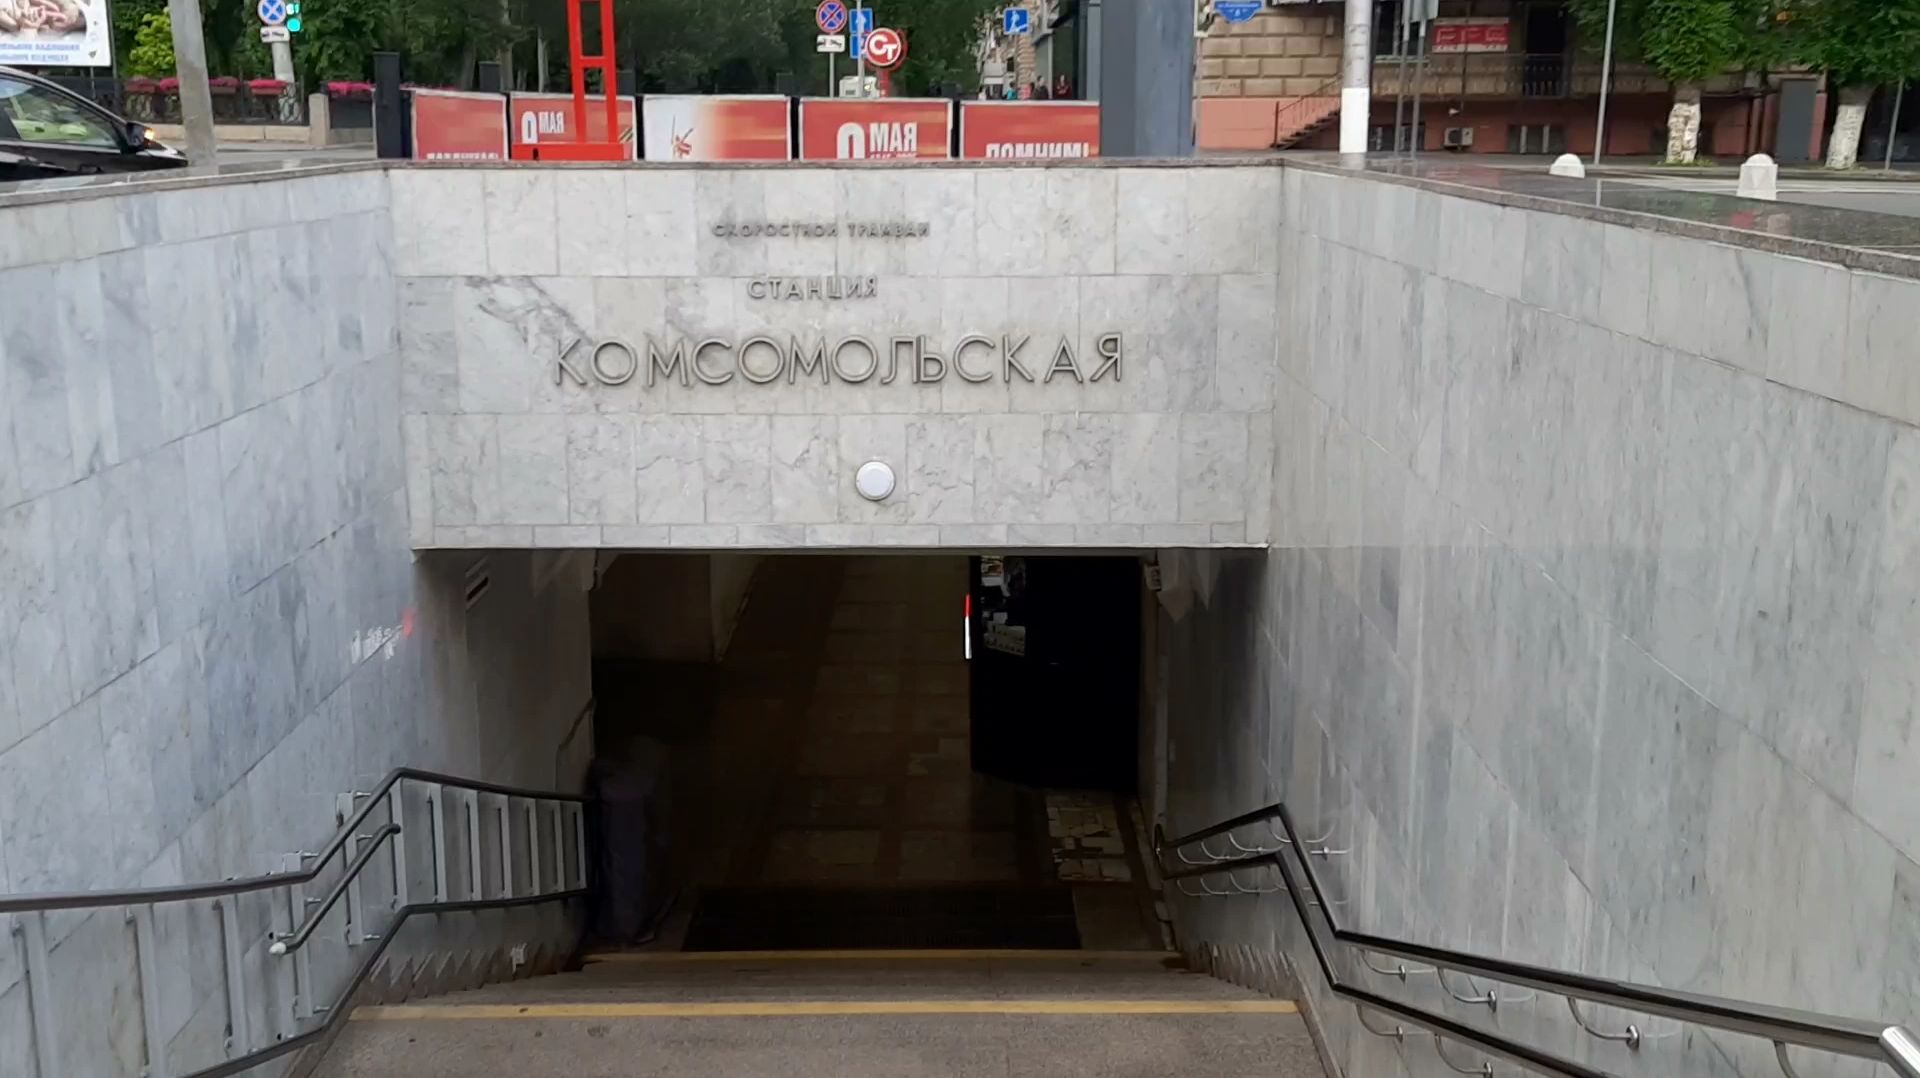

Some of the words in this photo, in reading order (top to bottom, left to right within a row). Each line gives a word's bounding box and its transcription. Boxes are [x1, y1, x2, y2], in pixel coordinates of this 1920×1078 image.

[869, 34, 898, 60] СТ
[538, 111, 565, 134] МАЯ
[869, 122, 918, 152] МАЯ
[747, 276, 878, 300] СТАНЦИЯ
[555, 332, 1123, 388] КОМСОМОЛЬСКАЯ
